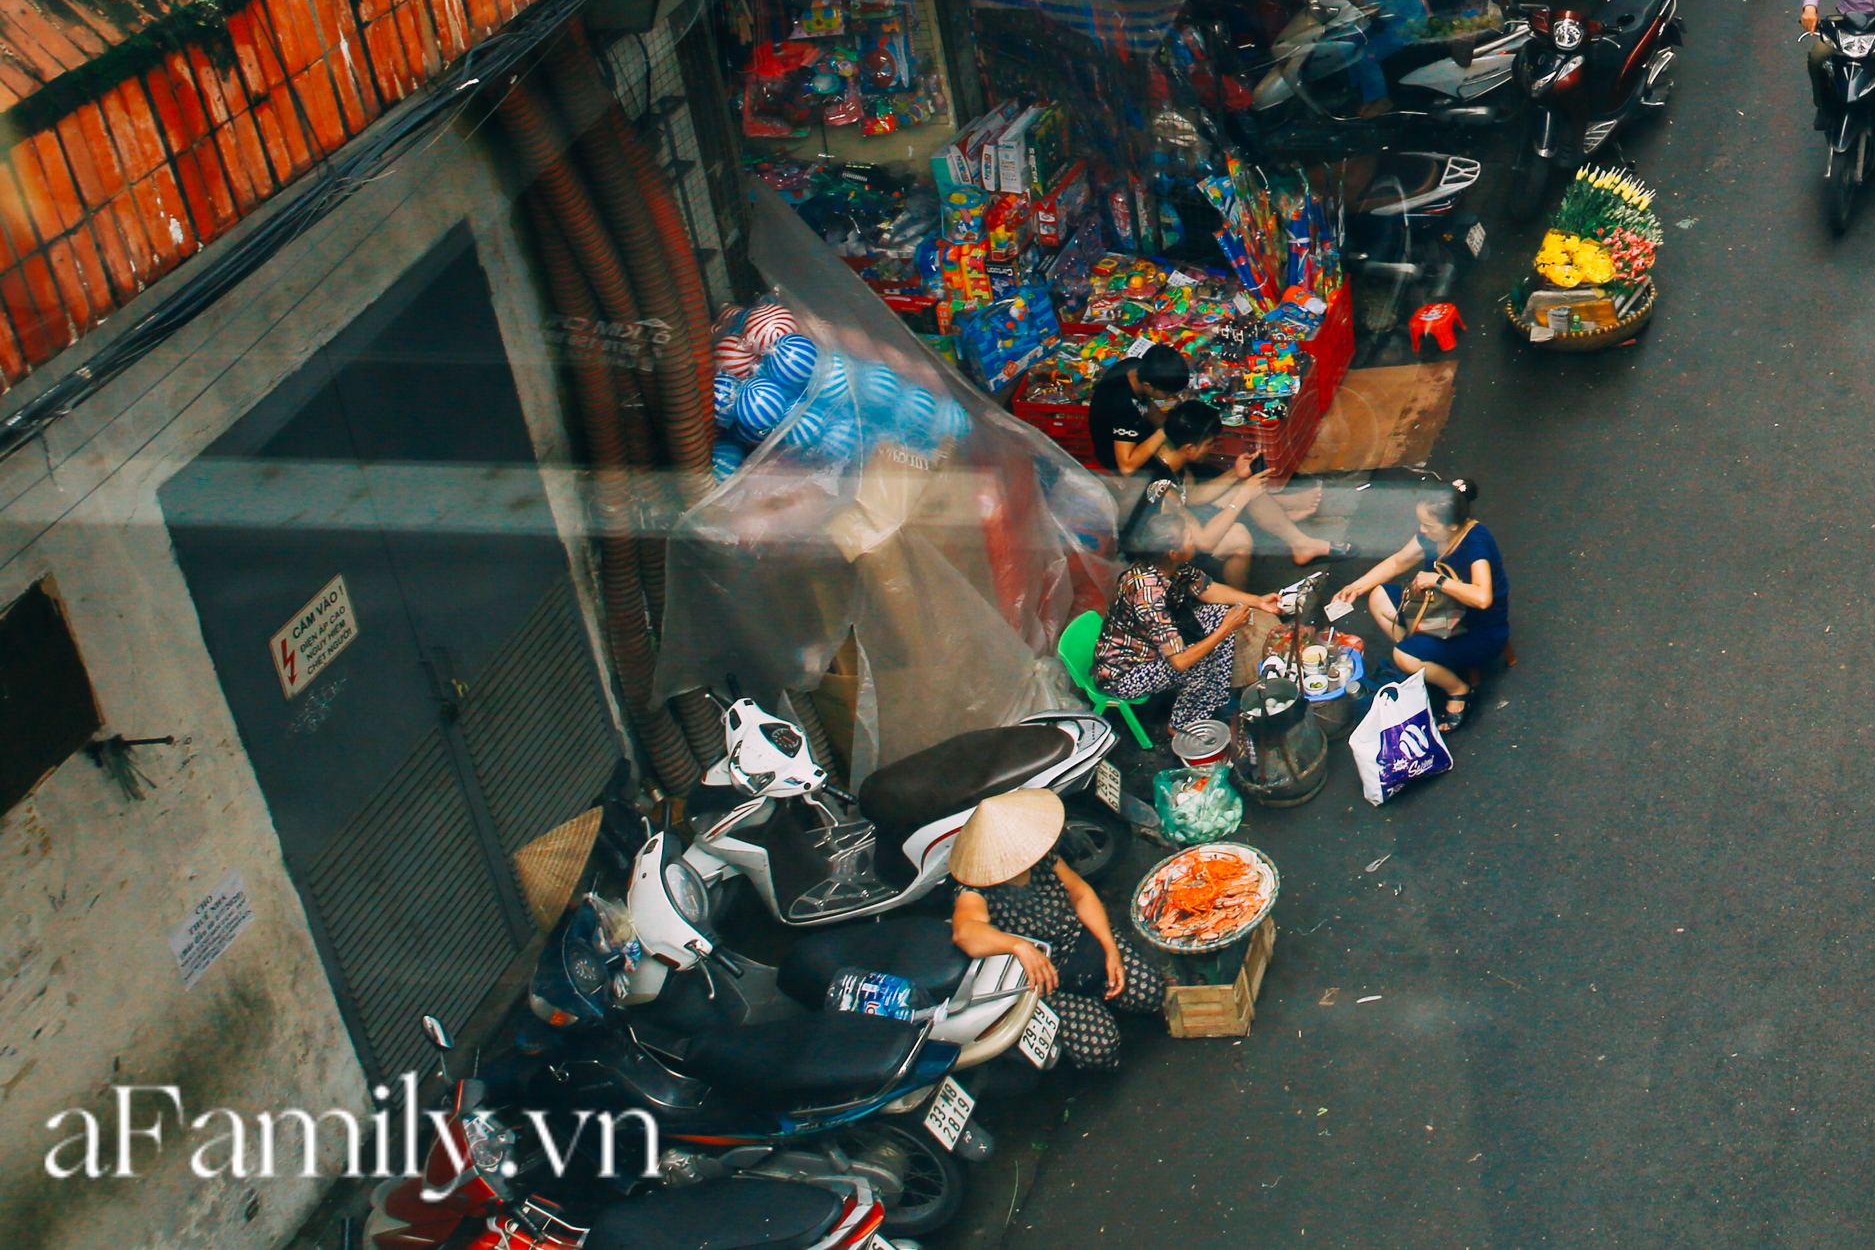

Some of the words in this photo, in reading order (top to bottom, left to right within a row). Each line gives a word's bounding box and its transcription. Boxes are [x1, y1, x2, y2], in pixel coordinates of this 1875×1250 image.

[316, 591, 338, 616] VÀO
[329, 605, 346, 624] CAO
[306, 637, 327, 661] NGUY
[1023, 1006, 1045, 1049] 29-Y9
[1034, 1016, 1057, 1060] 8975
[943, 1097, 970, 1143] 2819
